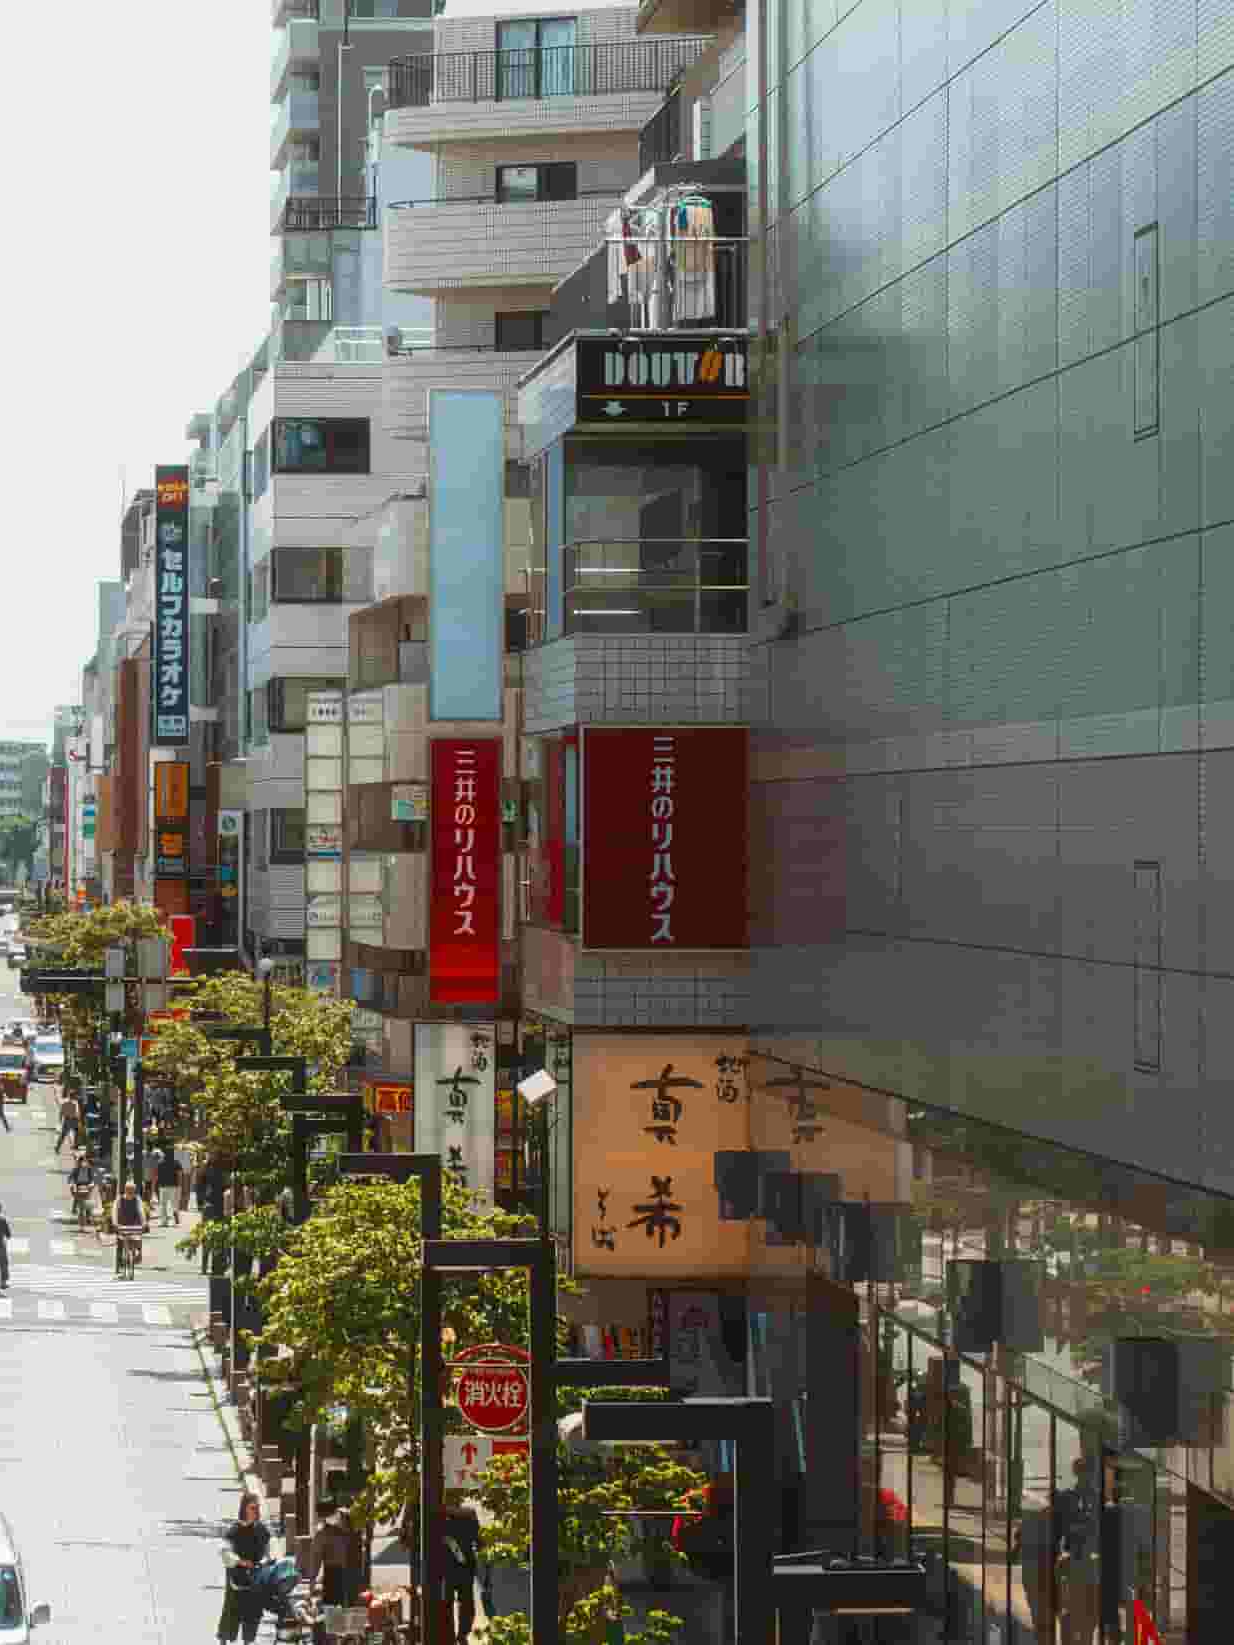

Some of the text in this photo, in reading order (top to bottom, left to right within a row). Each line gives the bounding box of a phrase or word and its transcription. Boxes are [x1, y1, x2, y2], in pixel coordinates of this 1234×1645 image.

[160, 548, 183, 707] セルフカラオケ
[452, 750, 477, 936] 三井のリハウス
[651, 736, 676, 944] 三井のリハウス
[464, 1380, 523, 1409] 消火栓
